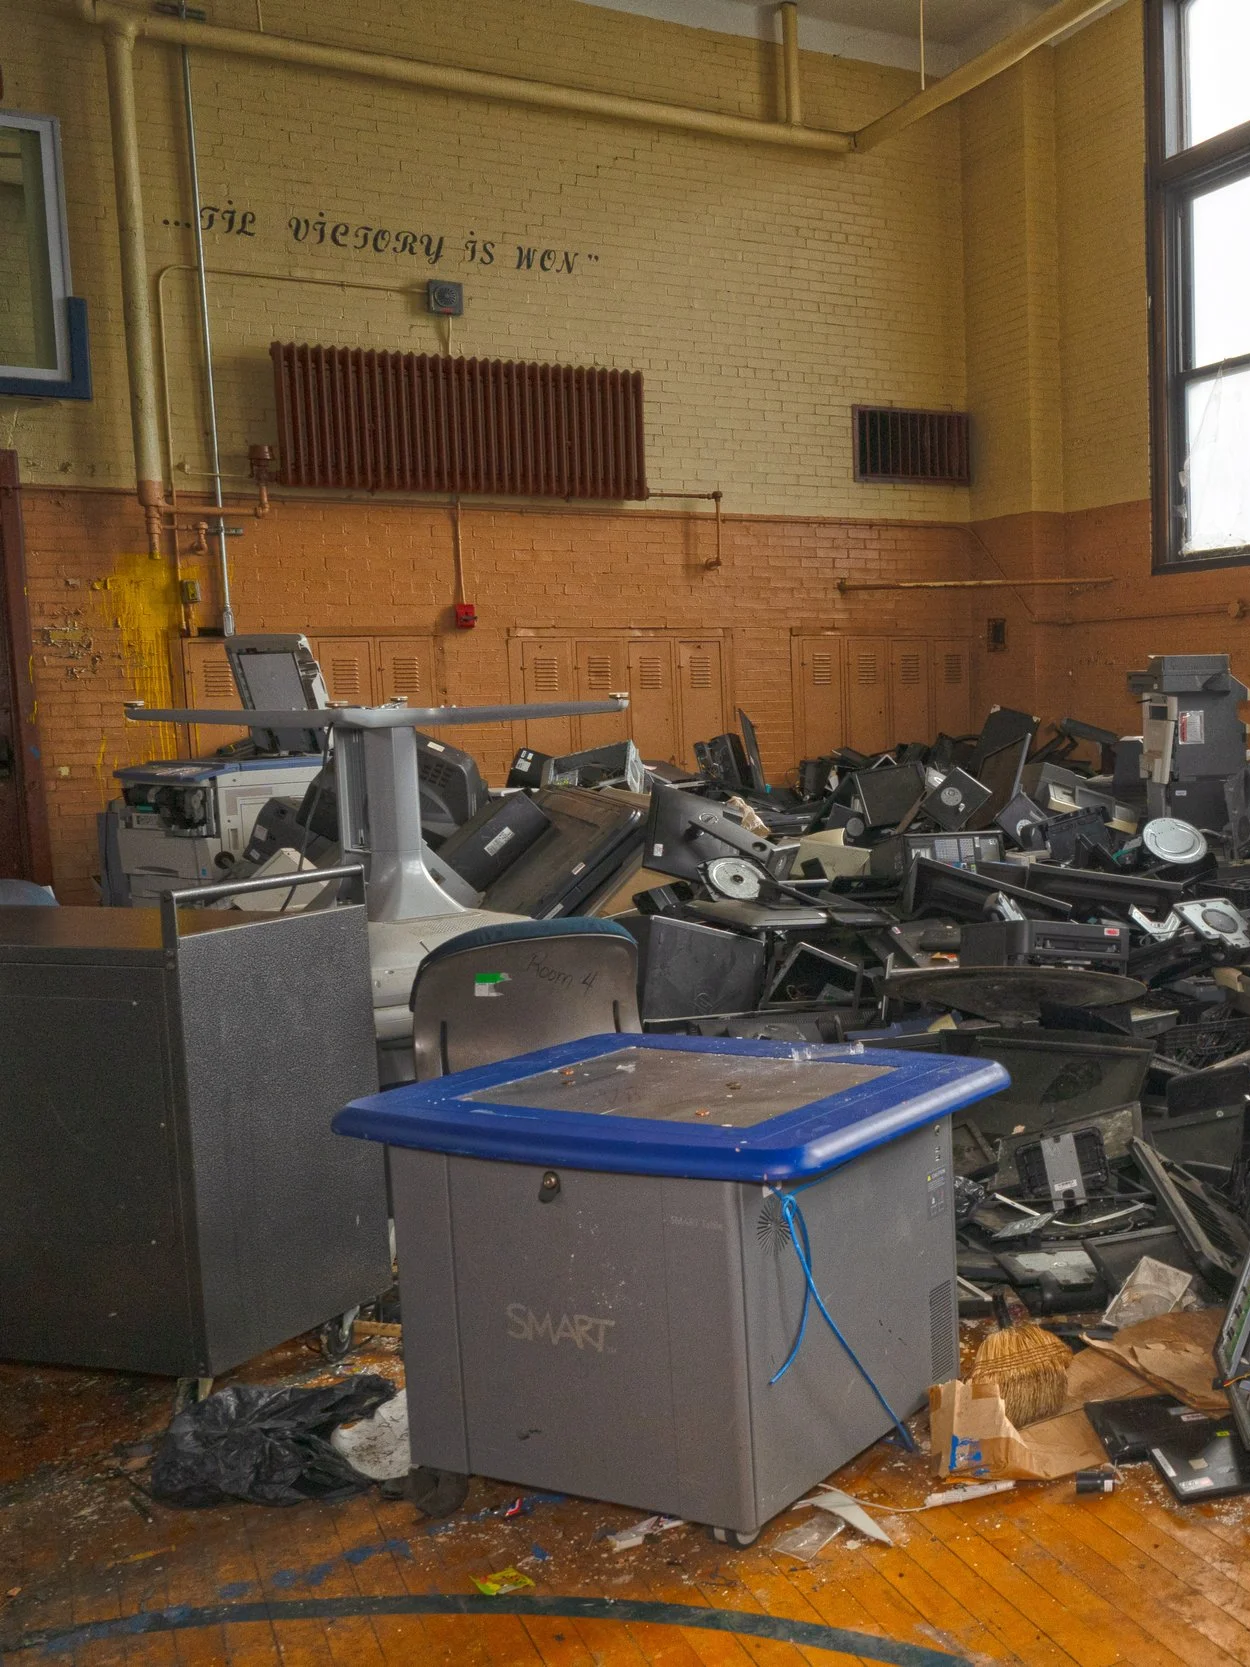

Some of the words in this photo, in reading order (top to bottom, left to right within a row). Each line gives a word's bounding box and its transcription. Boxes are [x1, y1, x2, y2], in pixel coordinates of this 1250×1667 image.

[288, 211, 445, 265] VICTORY
[465, 231, 496, 265] IS
[527, 951, 573, 987] Room
[581, 970, 597, 993] 4
[506, 1302, 616, 1352] SMART
